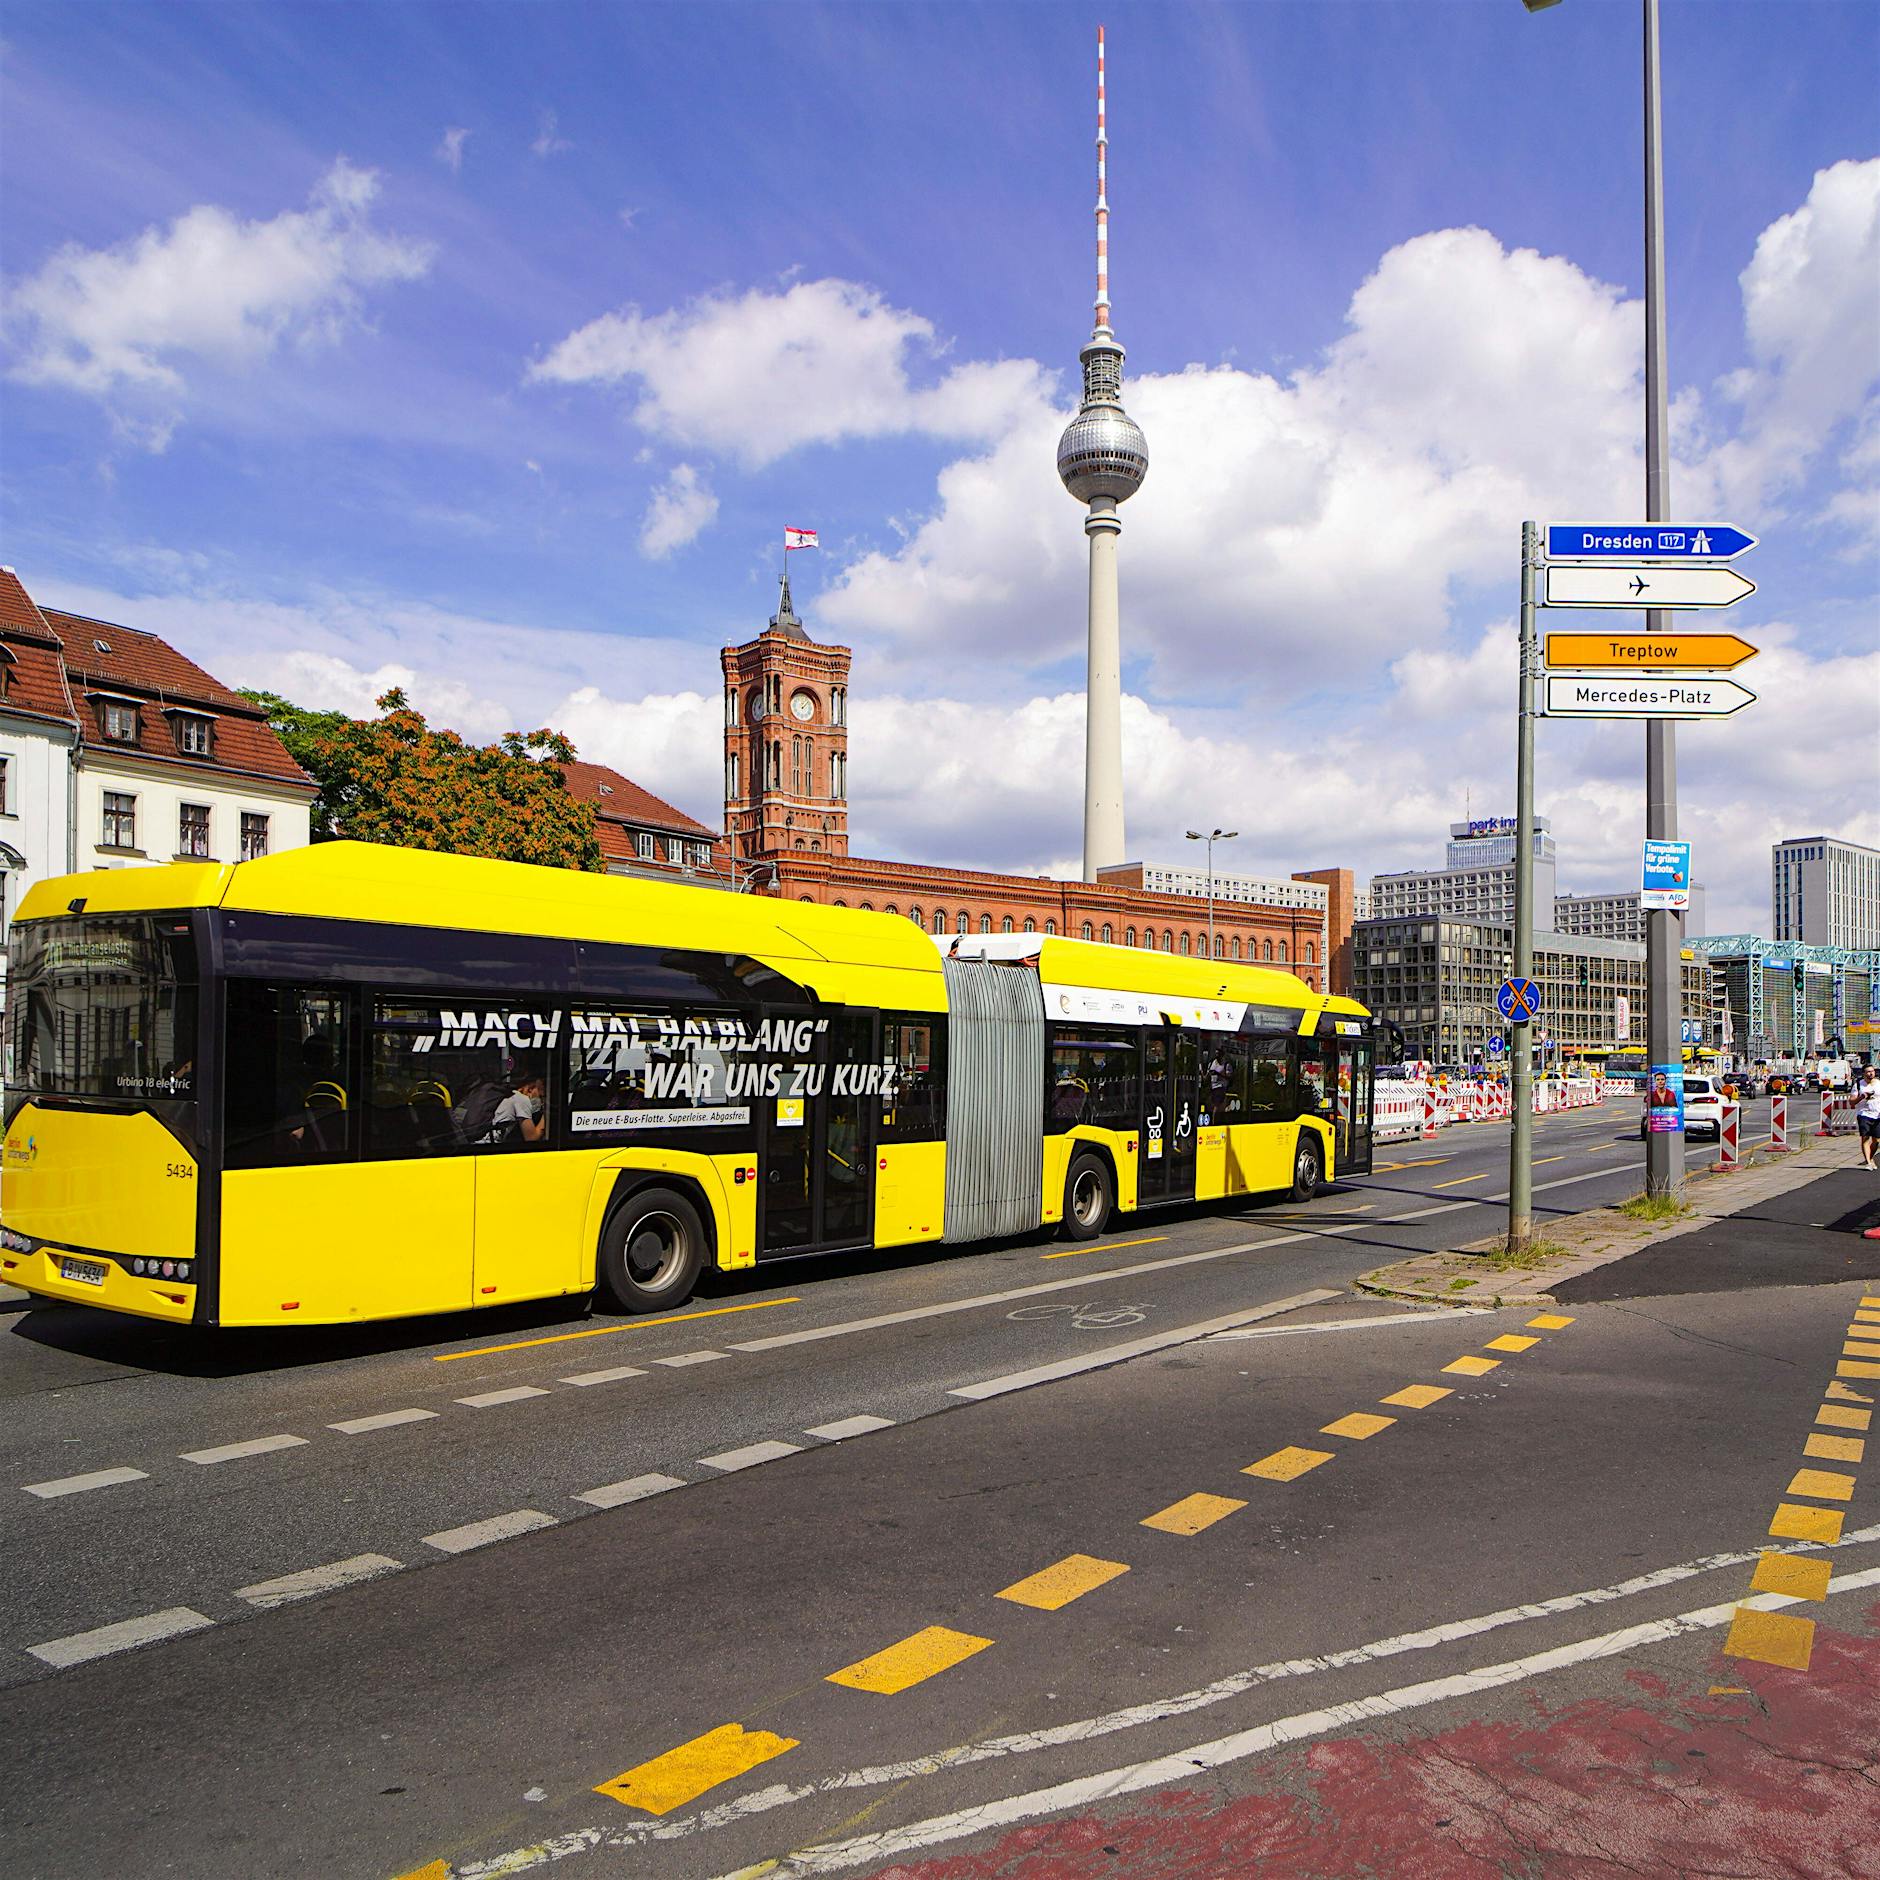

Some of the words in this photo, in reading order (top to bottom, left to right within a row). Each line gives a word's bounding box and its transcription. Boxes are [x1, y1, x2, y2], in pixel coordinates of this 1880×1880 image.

[1582, 533, 1653, 549] Dresden
[1664, 535, 1680, 547] 117
[1609, 643, 1678, 661] Treptow
[1576, 687, 1711, 704] Mercedes-Platz
[1469, 817, 1498, 834] park
[1646, 843, 1687, 856] Tempolimit
[1645, 853, 1657, 863] für
[1657, 854, 1680, 865] grüne
[1645, 863, 1676, 873] Verbote.
[570, 1016, 648, 1049] MAL
[116, 1076, 144, 1087] Urbino
[145, 1078, 155, 1088] 18
[156, 1078, 191, 1089] electric
[643, 1062, 715, 1099] WAR
[724, 1062, 783, 1098] UNS
[789, 1063, 827, 1097] ZU
[832, 1063, 900, 1096] KURZ.
[576, 1116, 590, 1126] Die
[592, 1116, 613, 1125] neue
[615, 1112, 666, 1124] E-Bus-Flotte.
[668, 1112, 708, 1124] Superleise.
[710, 1110, 746, 1121] Abgasfrei.
[166, 1163, 193, 1179] 5434
